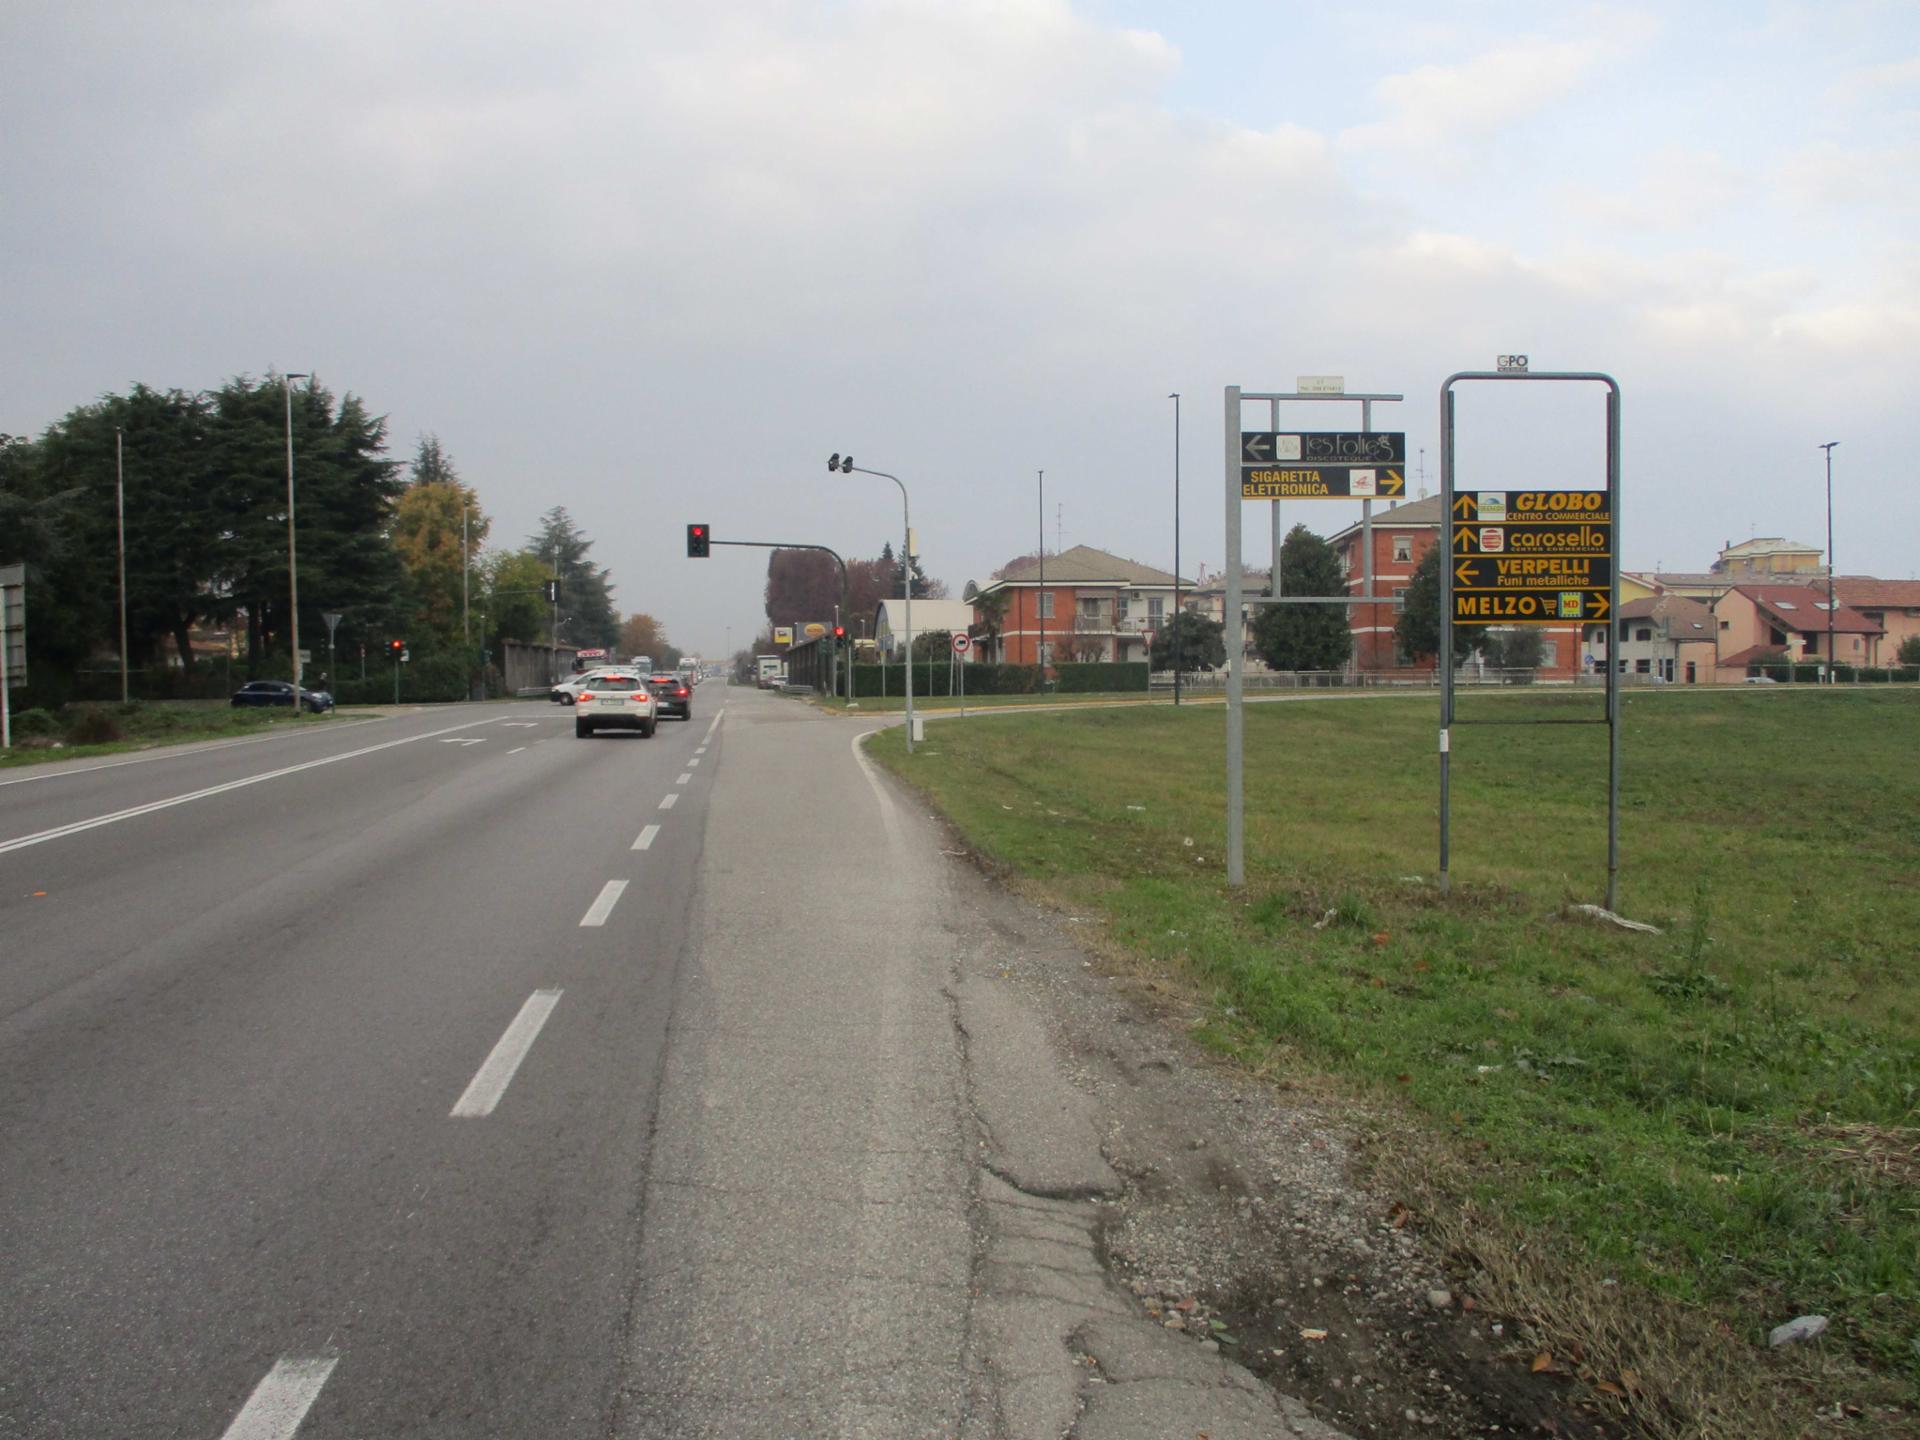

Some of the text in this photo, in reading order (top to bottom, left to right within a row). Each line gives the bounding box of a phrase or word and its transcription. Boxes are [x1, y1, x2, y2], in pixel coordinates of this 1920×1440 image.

[1497, 355, 1528, 367] GPO
[1250, 471, 1321, 483] SIGARETTA
[1243, 483, 1328, 496] ELETTRONICA
[1516, 493, 1602, 511] GLOBO
[1506, 512, 1610, 520] CENTRO COMMERCIALE
[1510, 526, 1604, 547] carosello
[1497, 559, 1590, 574] VERPELLI
[1497, 575, 1590, 586] Funi metalliche
[1457, 596, 1537, 615] MELZO
[1564, 600, 1578, 608] MD
